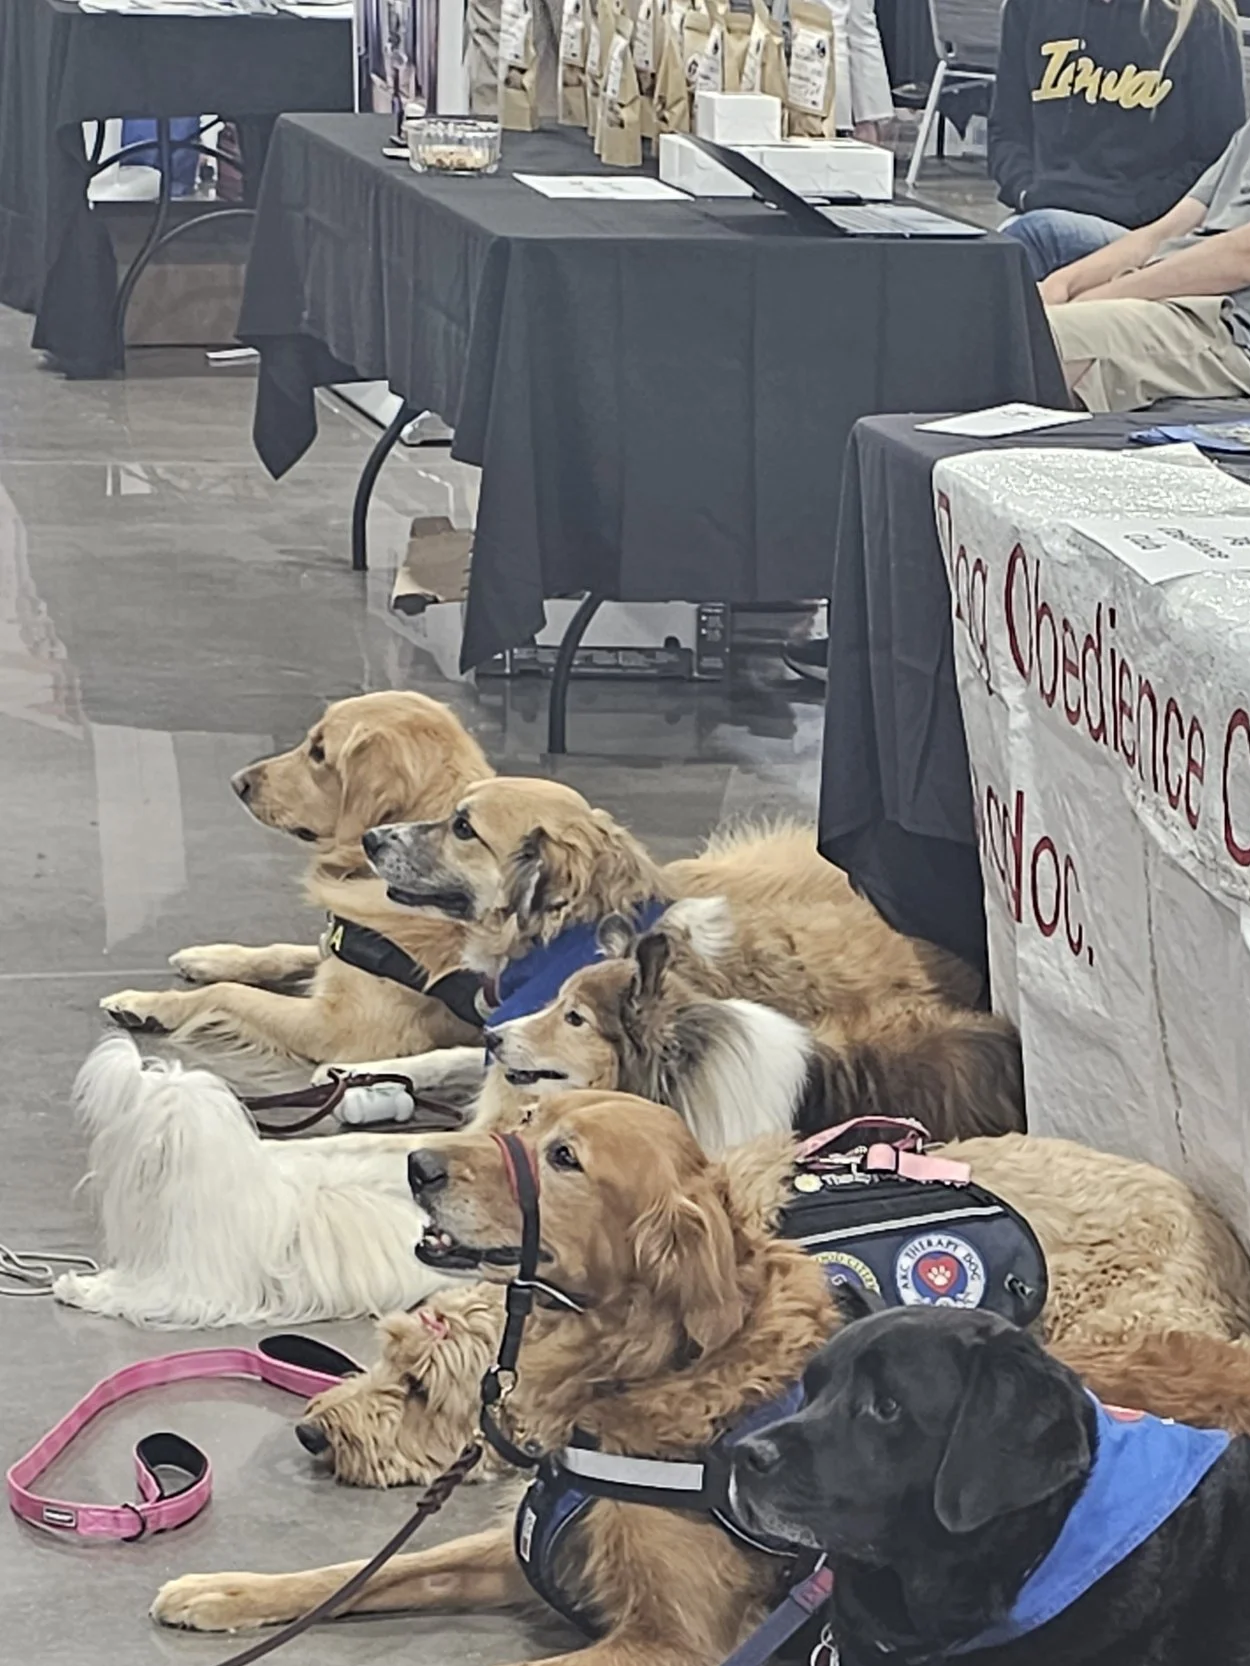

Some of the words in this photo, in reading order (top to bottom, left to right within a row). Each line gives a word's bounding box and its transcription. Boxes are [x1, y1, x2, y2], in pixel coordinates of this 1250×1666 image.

[1004, 542, 1206, 830] Obedience
[904, 1238, 959, 1259] THERAPY
[899, 1265, 911, 1289] AKC
[963, 1253, 981, 1281] DOG
